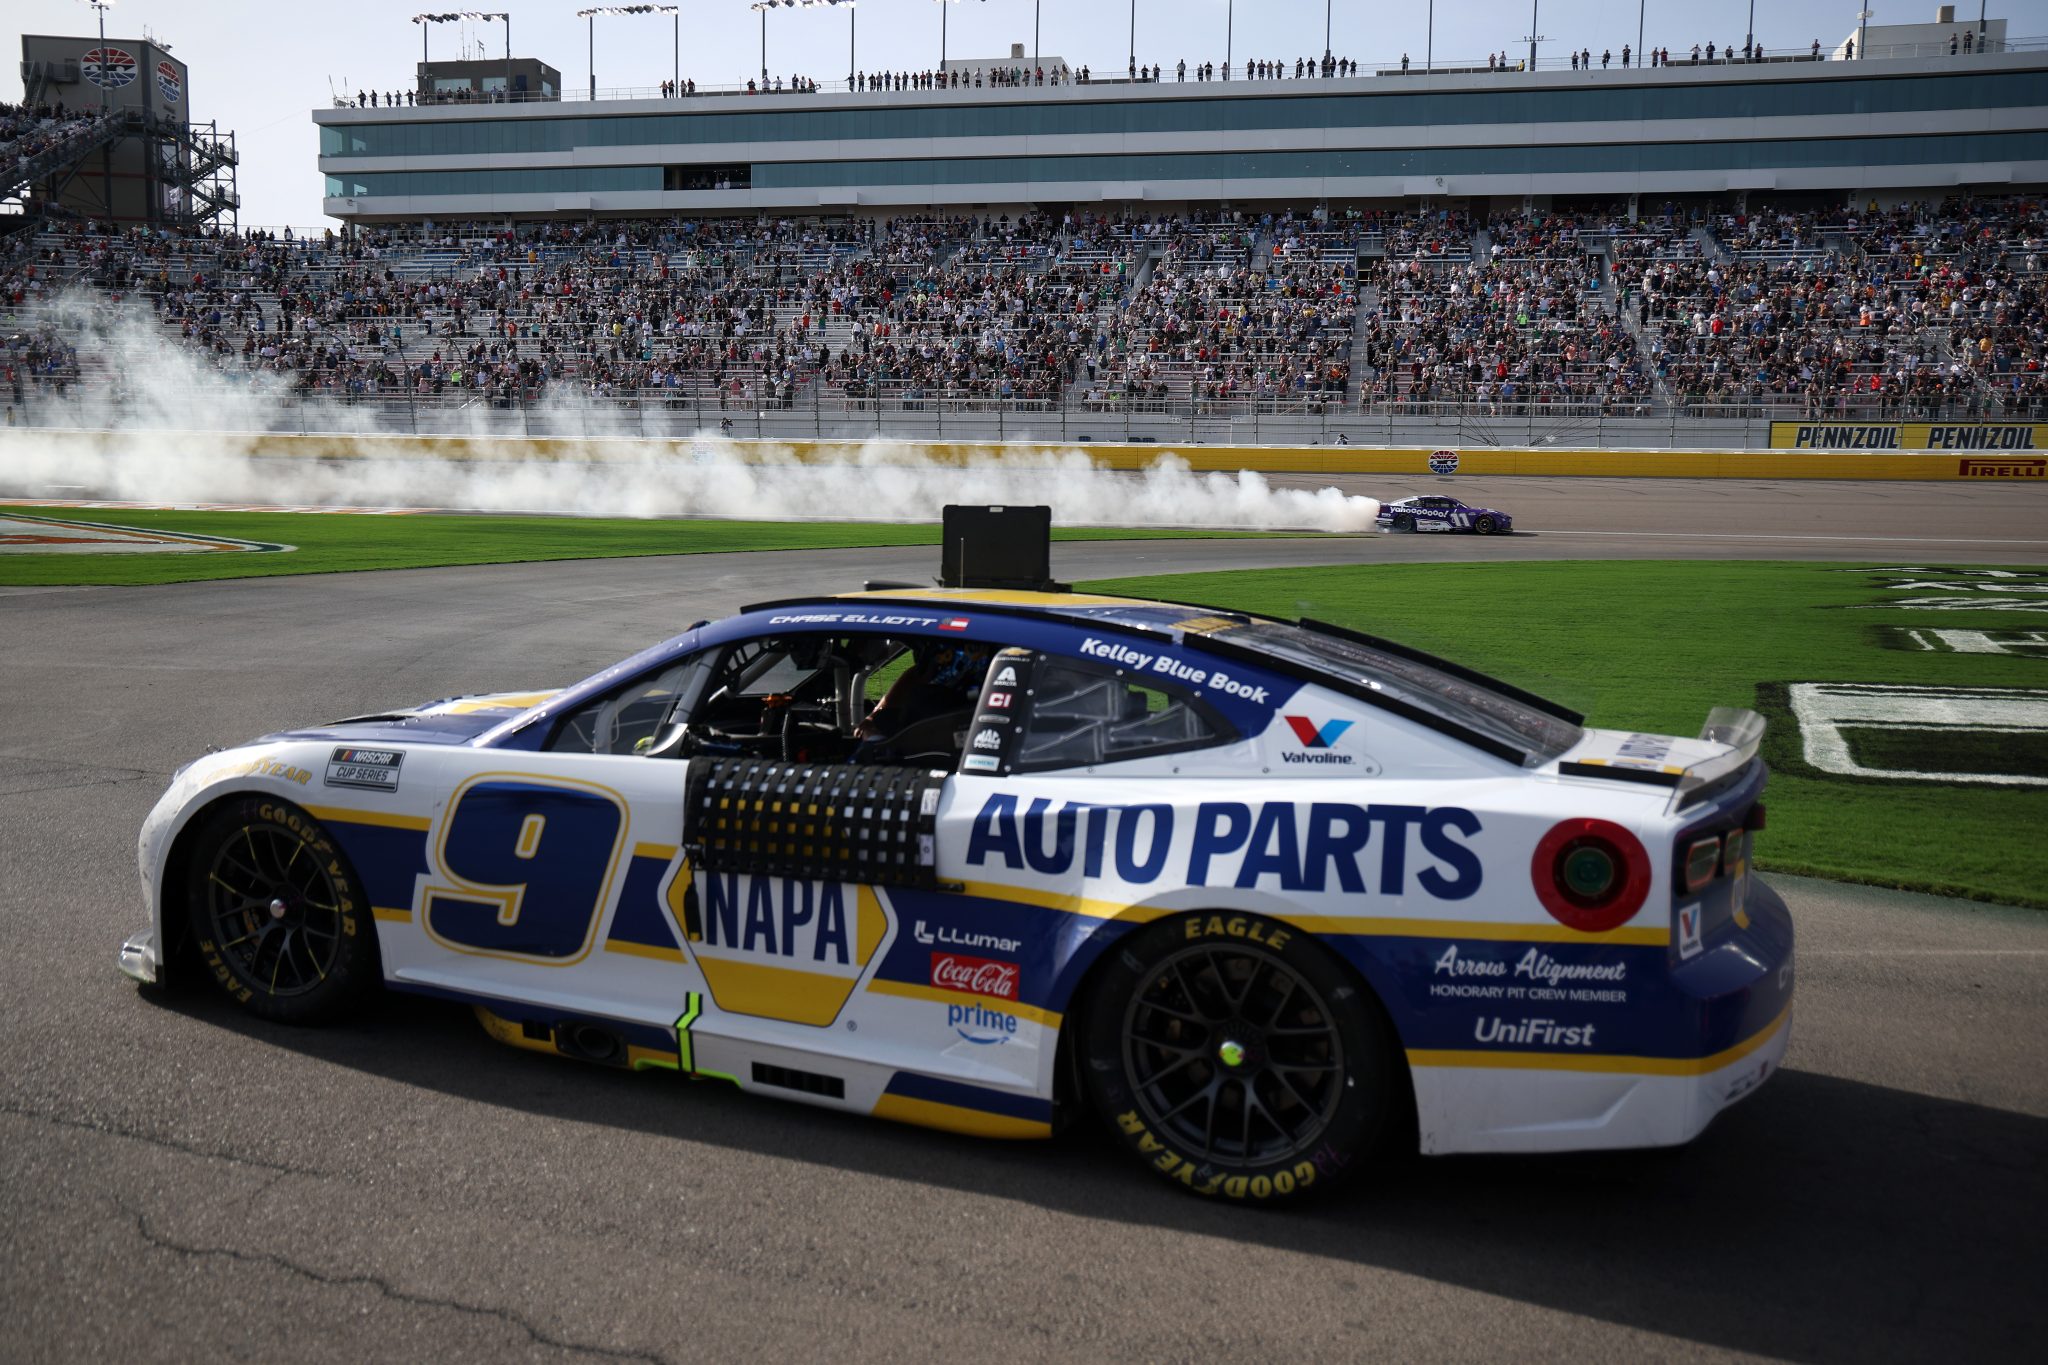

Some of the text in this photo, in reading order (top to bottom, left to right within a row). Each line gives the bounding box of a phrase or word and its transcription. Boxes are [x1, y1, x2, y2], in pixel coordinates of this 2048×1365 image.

[1795, 426, 1899, 449] PENNZOIL
[1926, 426, 2035, 449] PENNZOIL
[1959, 459, 2047, 477] PIRELLI
[1451, 512, 1470, 527] 11
[769, 614, 938, 627] CHASE ELLIOTT
[1080, 637, 1270, 705] Kelley Blue Book
[352, 750, 394, 765] NASCAR
[1281, 752, 1353, 765] Valvoline
[336, 766, 389, 782] CUP SERIES
[966, 793, 1484, 901] AUTO PARTS
[421, 771, 631, 967] 9
[706, 871, 849, 965] NAPA
[1185, 916, 1291, 950] EAGLE
[200, 939, 254, 1004] EAGLE
[1434, 944, 1626, 986] Arrow Alignment
[1430, 984, 1626, 1002] HONORARY PIT CREW MEMBER
[948, 1002, 1017, 1033] prime
[1474, 1016, 1596, 1047] UniFirst
[1116, 1110, 1316, 1198] GOODYEAR
